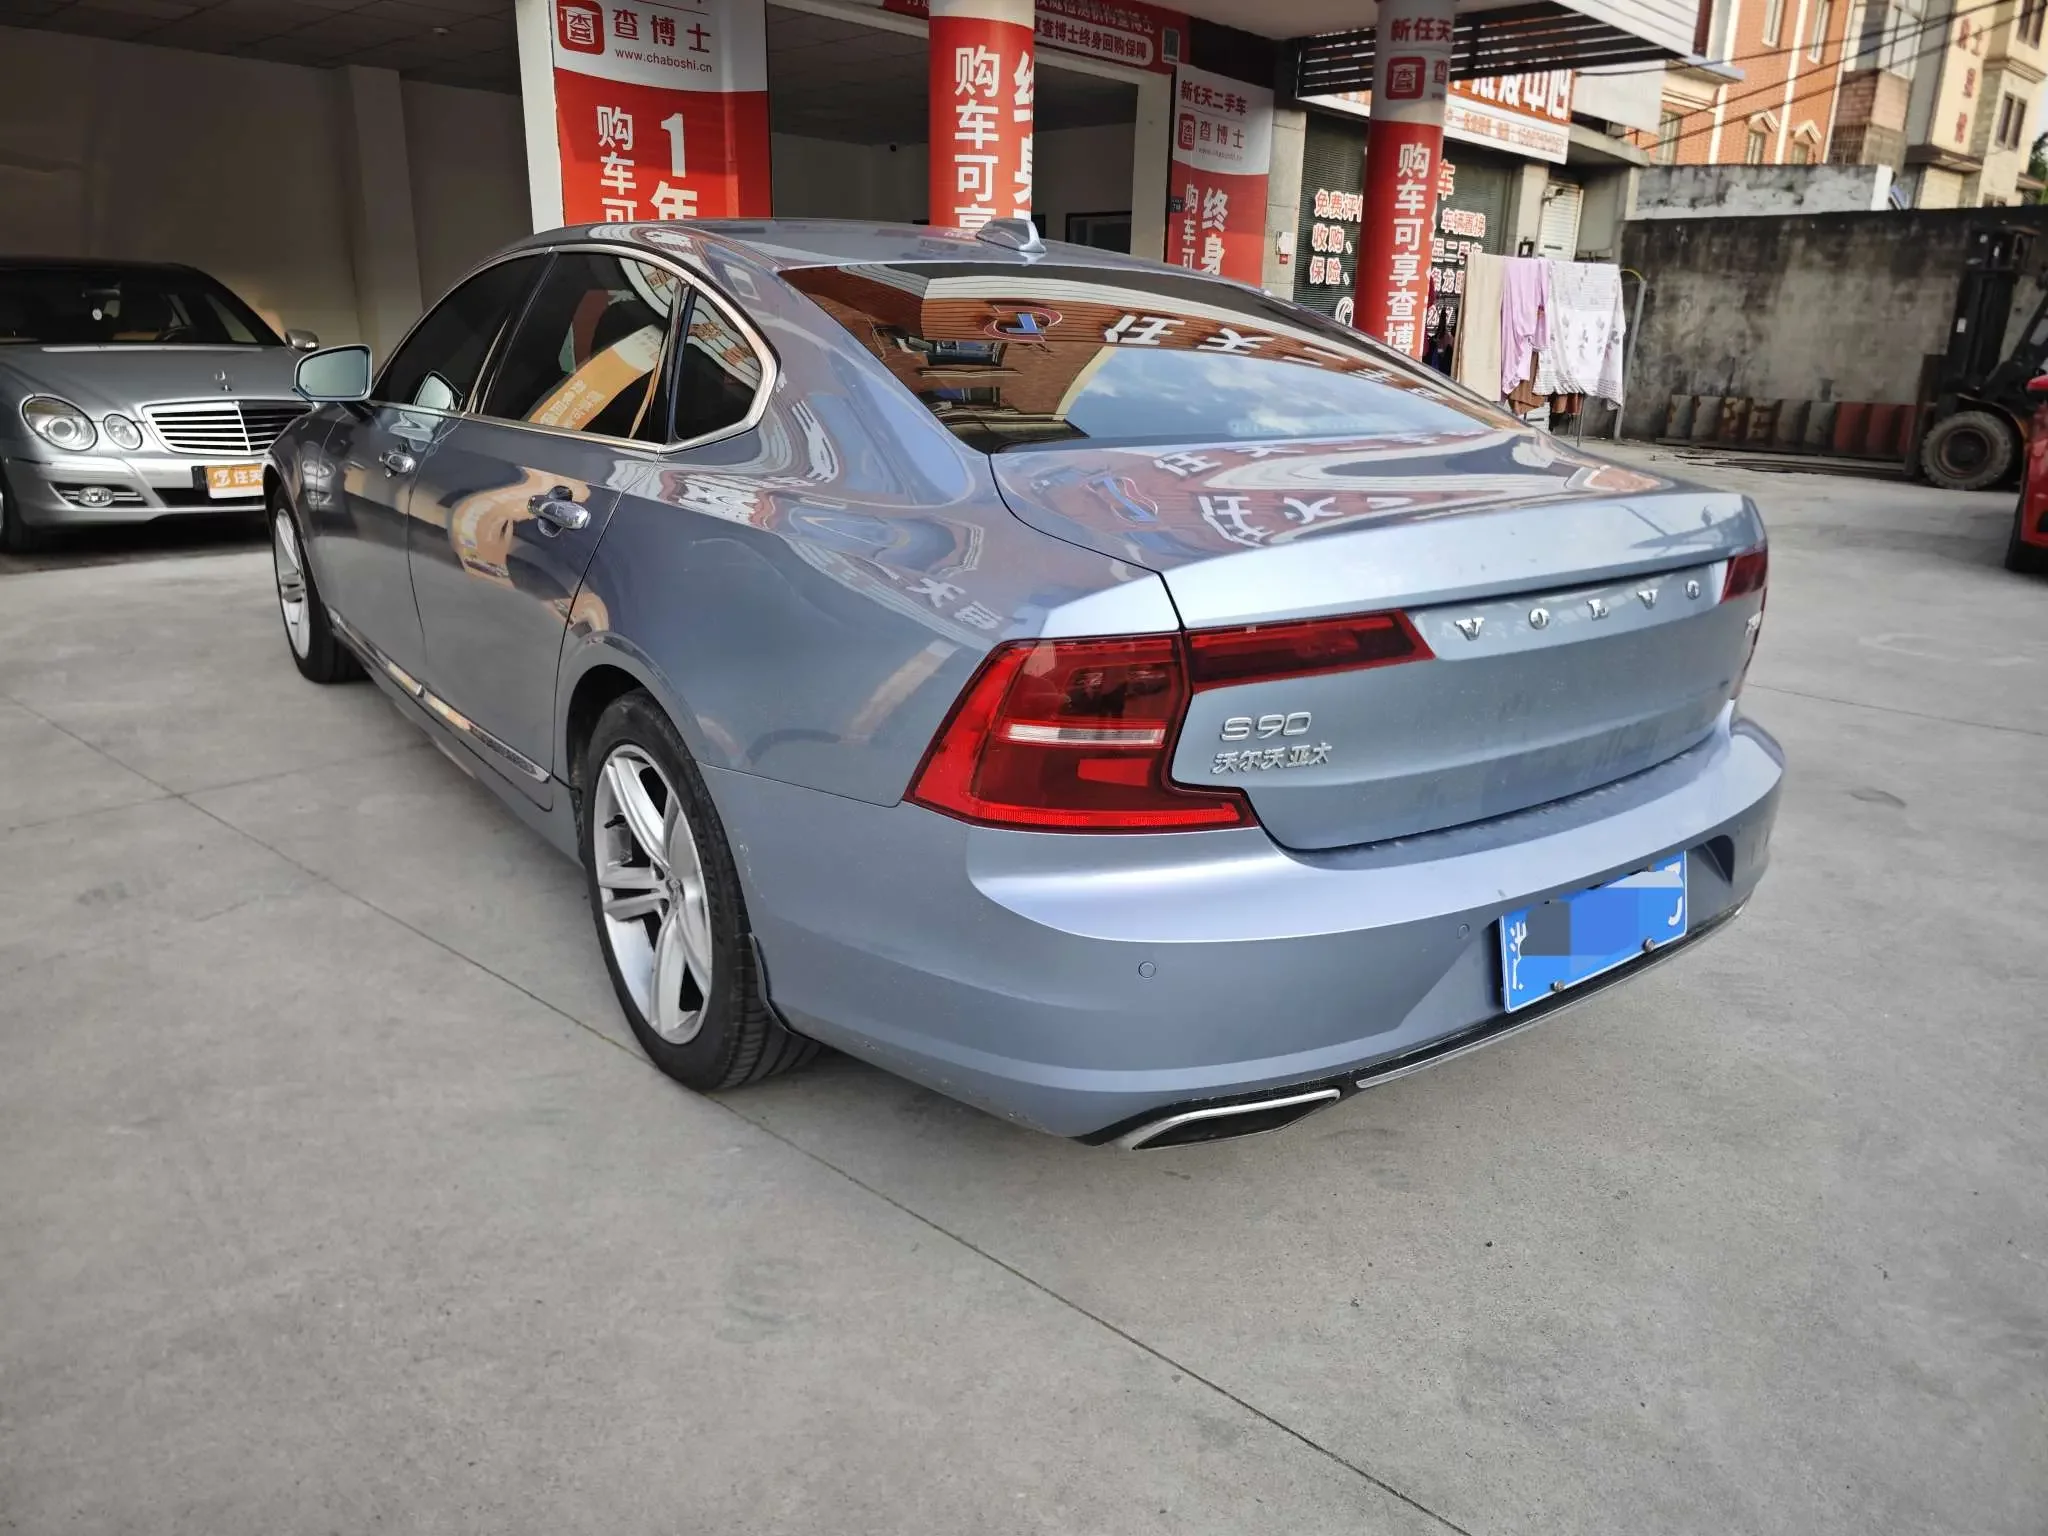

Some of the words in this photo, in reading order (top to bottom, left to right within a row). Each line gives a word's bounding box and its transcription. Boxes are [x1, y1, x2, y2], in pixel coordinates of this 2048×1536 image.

[612, 9, 712, 53] 查博士
[1391, 17, 1452, 42] 新任天
[615, 48, 712, 73] www.chaboshi.cn
[1181, 80, 1247, 116] 新任天二手车
[1200, 120, 1244, 149] 查博士
[1201, 187, 1228, 276] 终身
[1455, 579, 1701, 641] VOLVO
[1220, 711, 1312, 741] S90
[1210, 741, 1333, 775] 沃尔沃亚太
